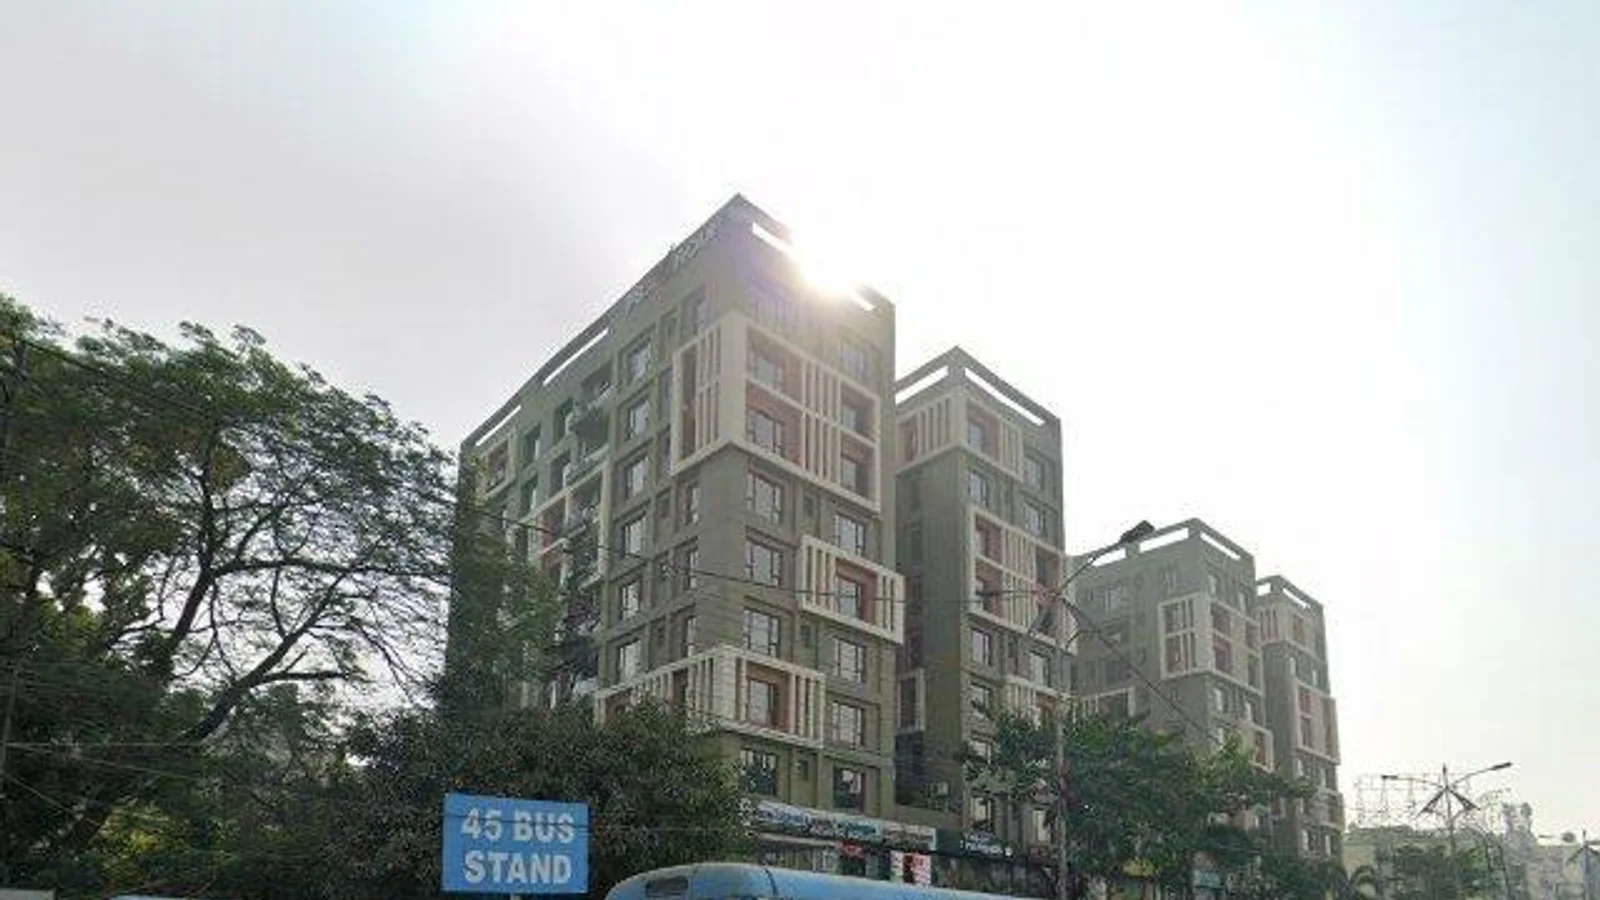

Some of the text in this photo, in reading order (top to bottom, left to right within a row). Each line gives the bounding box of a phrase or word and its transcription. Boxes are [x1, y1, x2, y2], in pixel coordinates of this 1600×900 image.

[460, 808, 574, 843] 45 BUS
[463, 850, 572, 884] STAND
